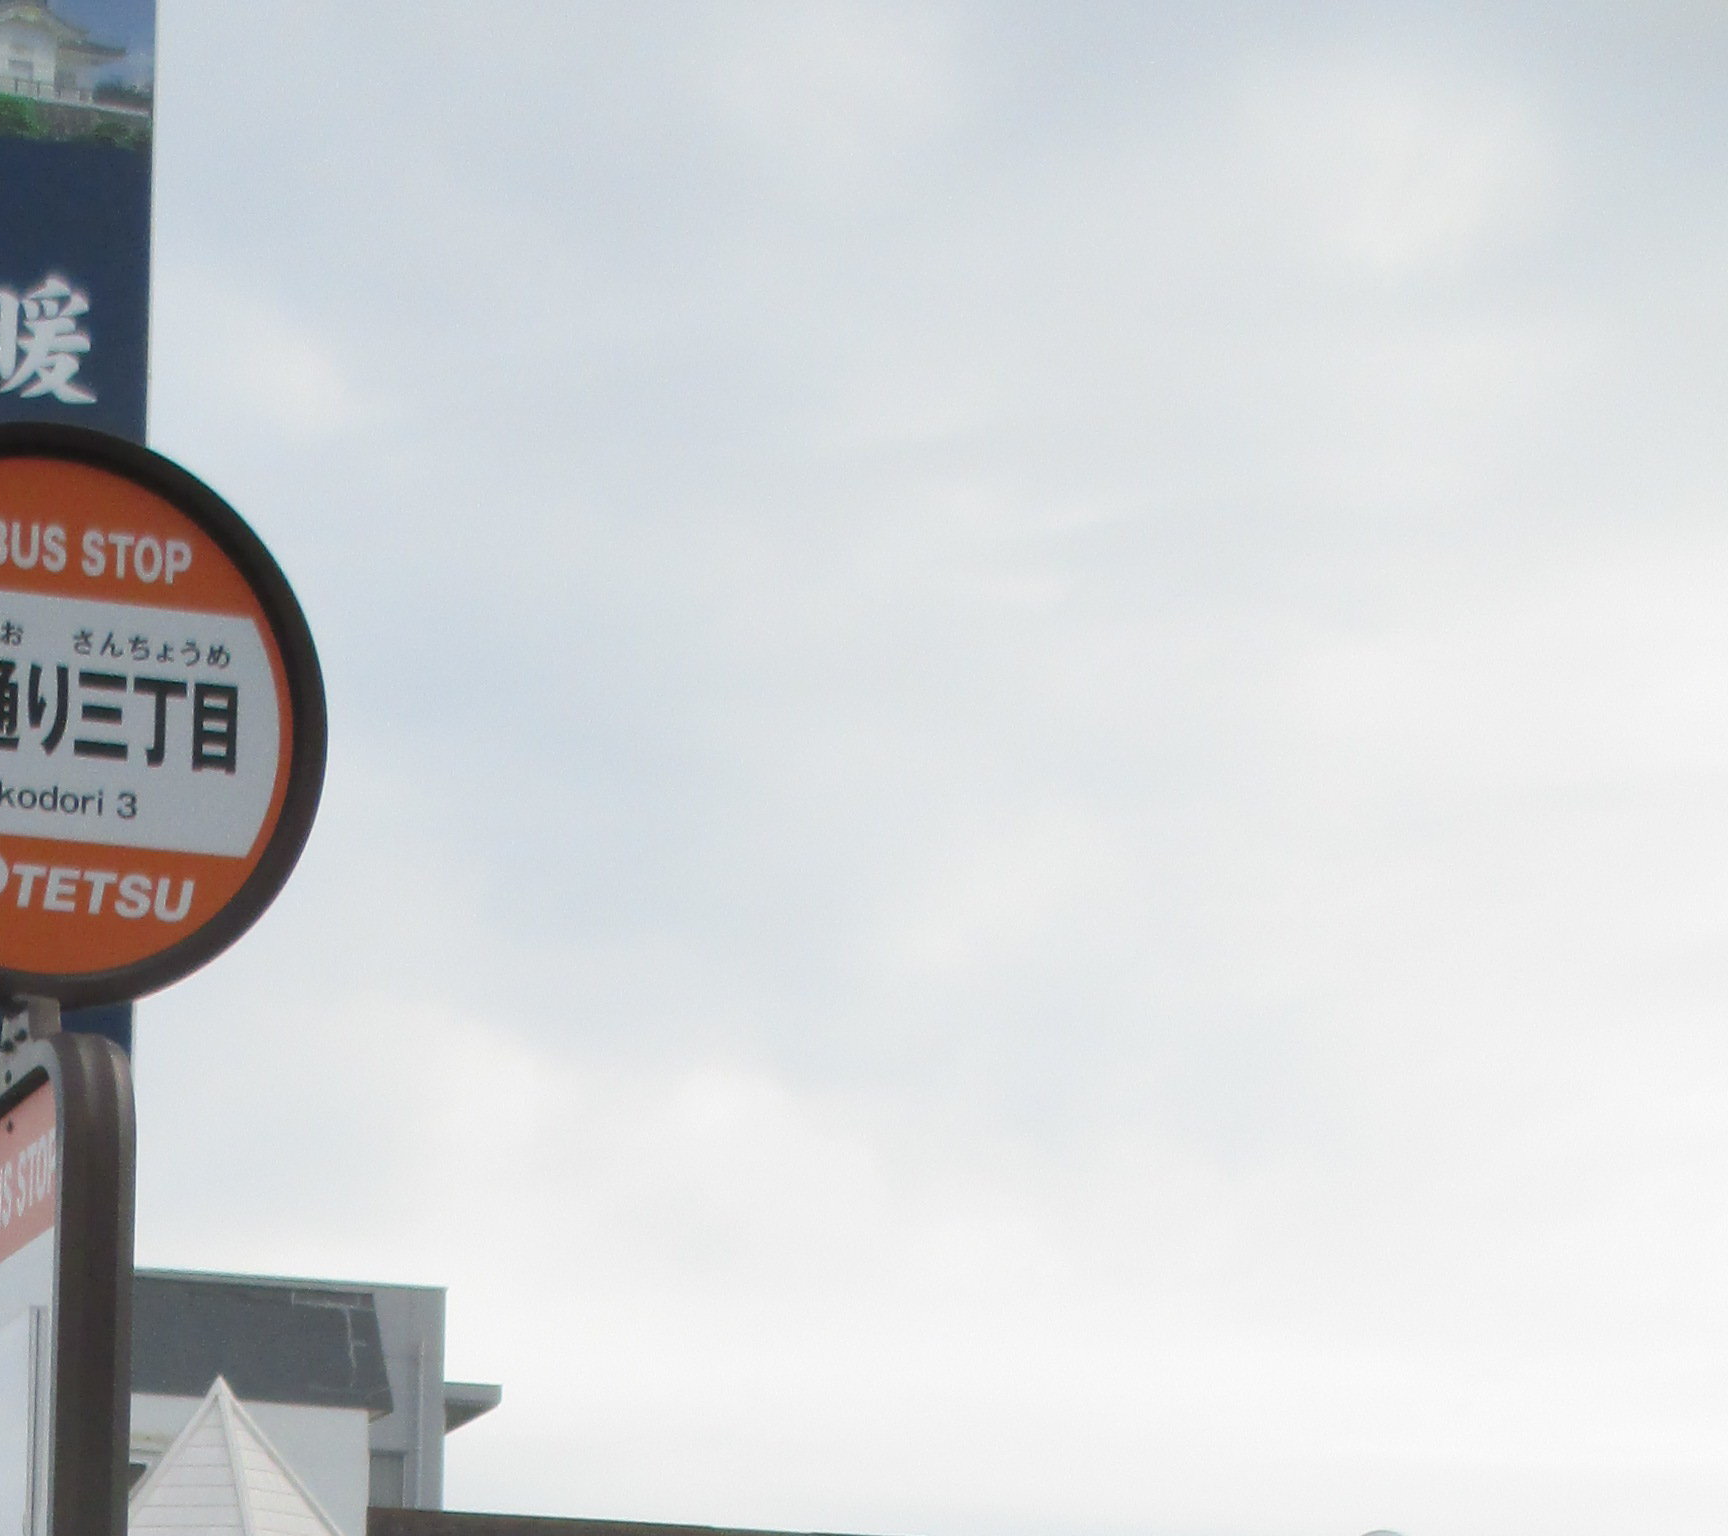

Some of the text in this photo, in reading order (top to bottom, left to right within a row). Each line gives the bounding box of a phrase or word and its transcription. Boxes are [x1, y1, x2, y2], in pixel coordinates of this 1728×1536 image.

[81, 531, 192, 584] STOP
[73, 629, 231, 669] さんちょうめ
[117, 787, 139, 819] 3
